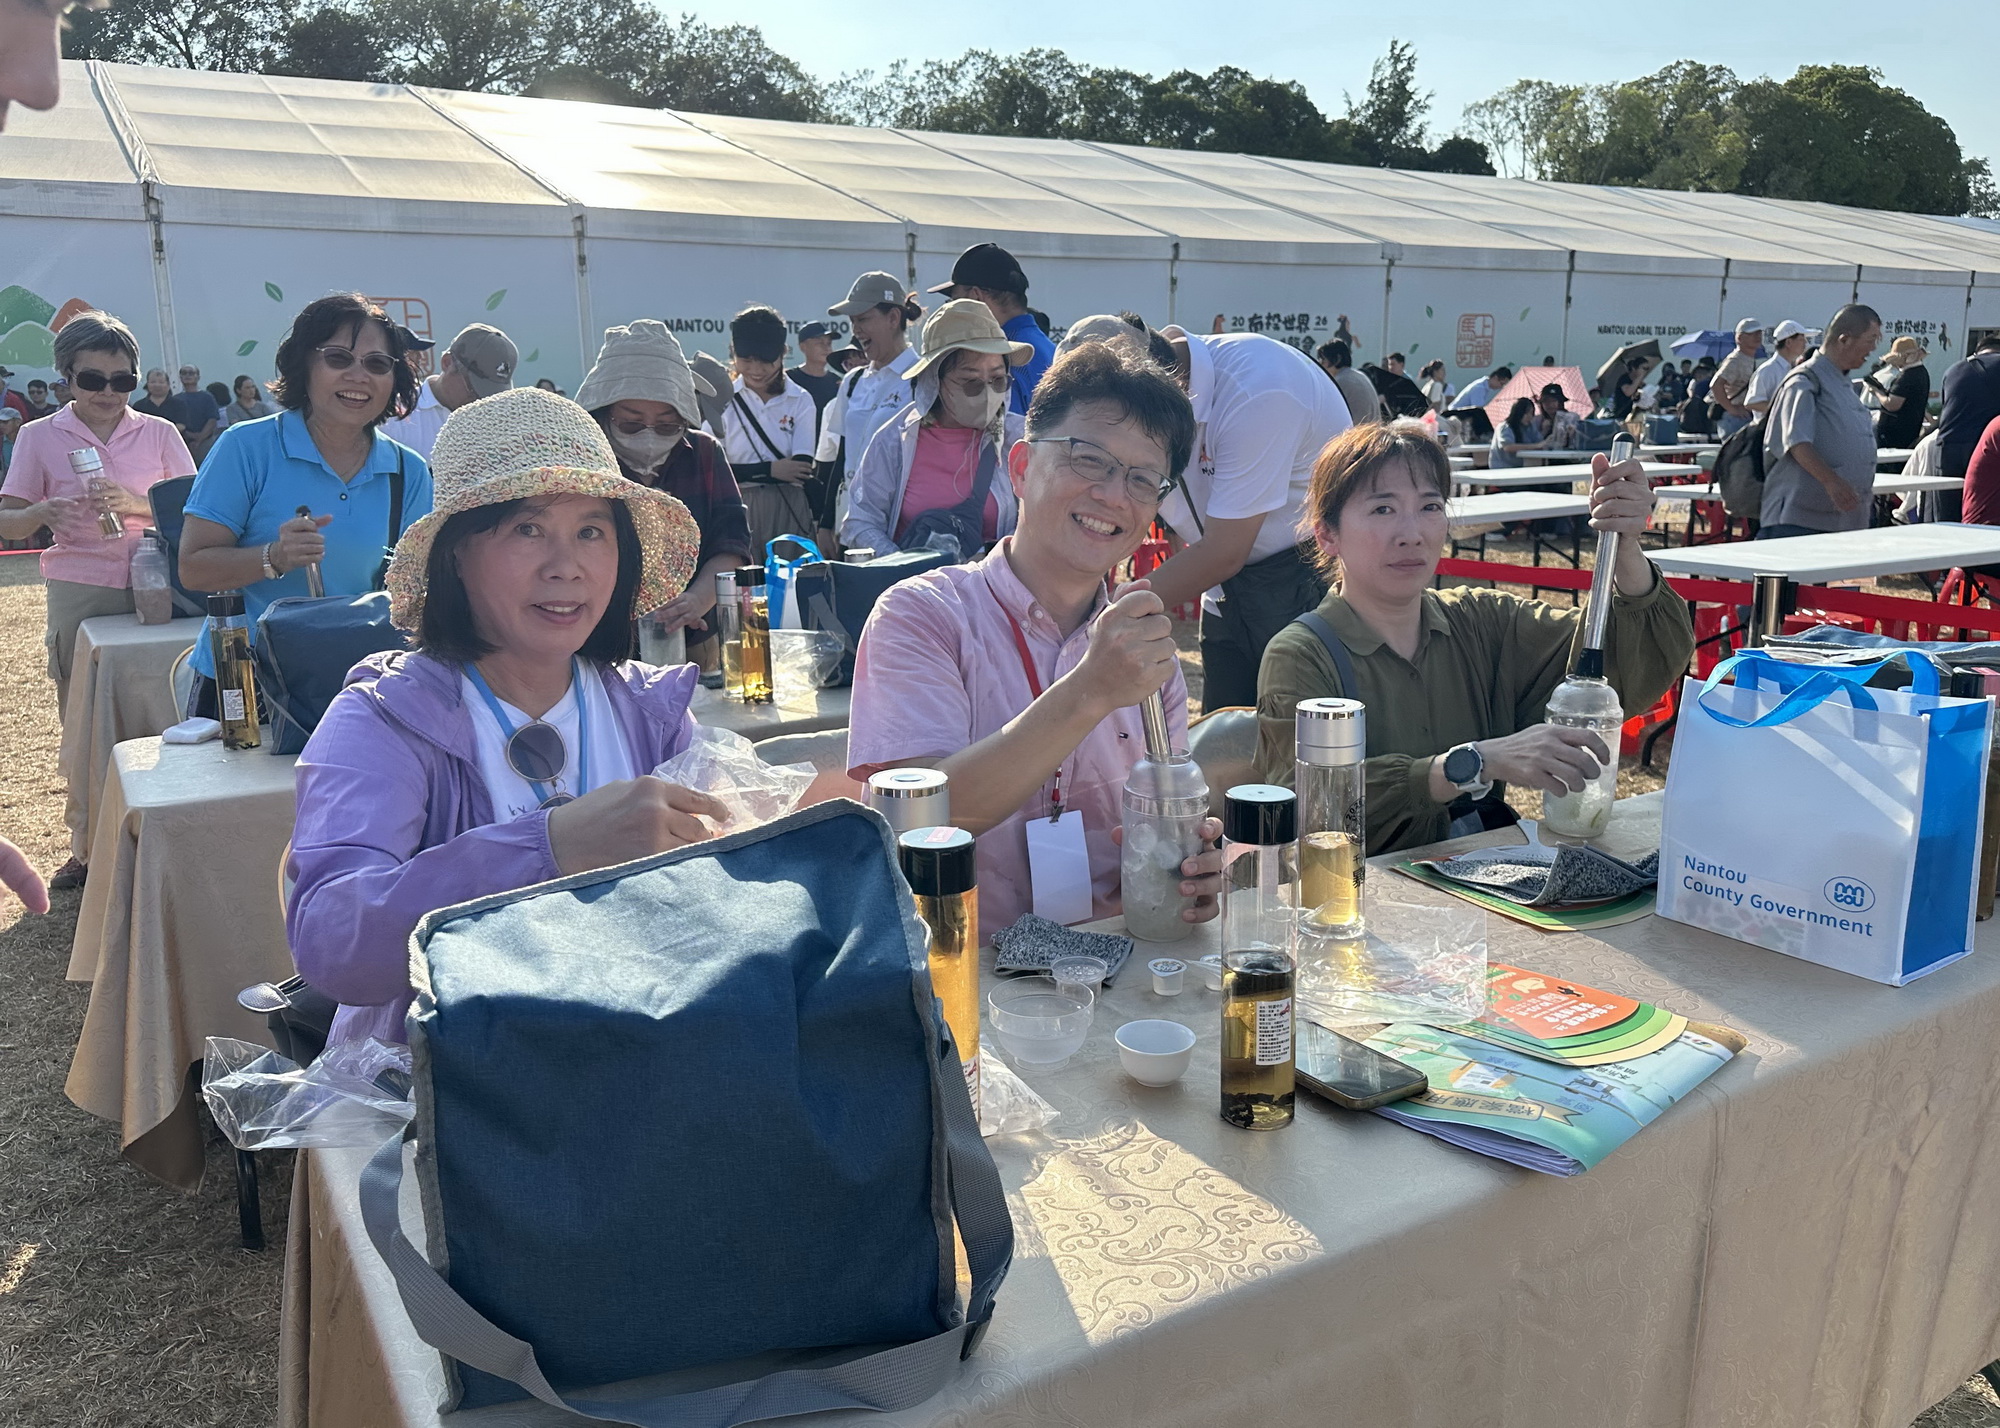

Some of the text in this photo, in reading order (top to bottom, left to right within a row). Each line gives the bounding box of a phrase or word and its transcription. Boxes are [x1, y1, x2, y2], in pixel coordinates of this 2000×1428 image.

[664, 318, 724, 334] NANTOU
[1231, 316, 1245, 327] 20
[1315, 316, 1328, 326] 26
[1597, 325, 1625, 335] NANTOU
[1627, 325, 1653, 335] GLOBAL
[1668, 326, 1687, 336] EXPO
[1684, 855, 1747, 884] Nantou
[1683, 875, 1873, 937] County Government
